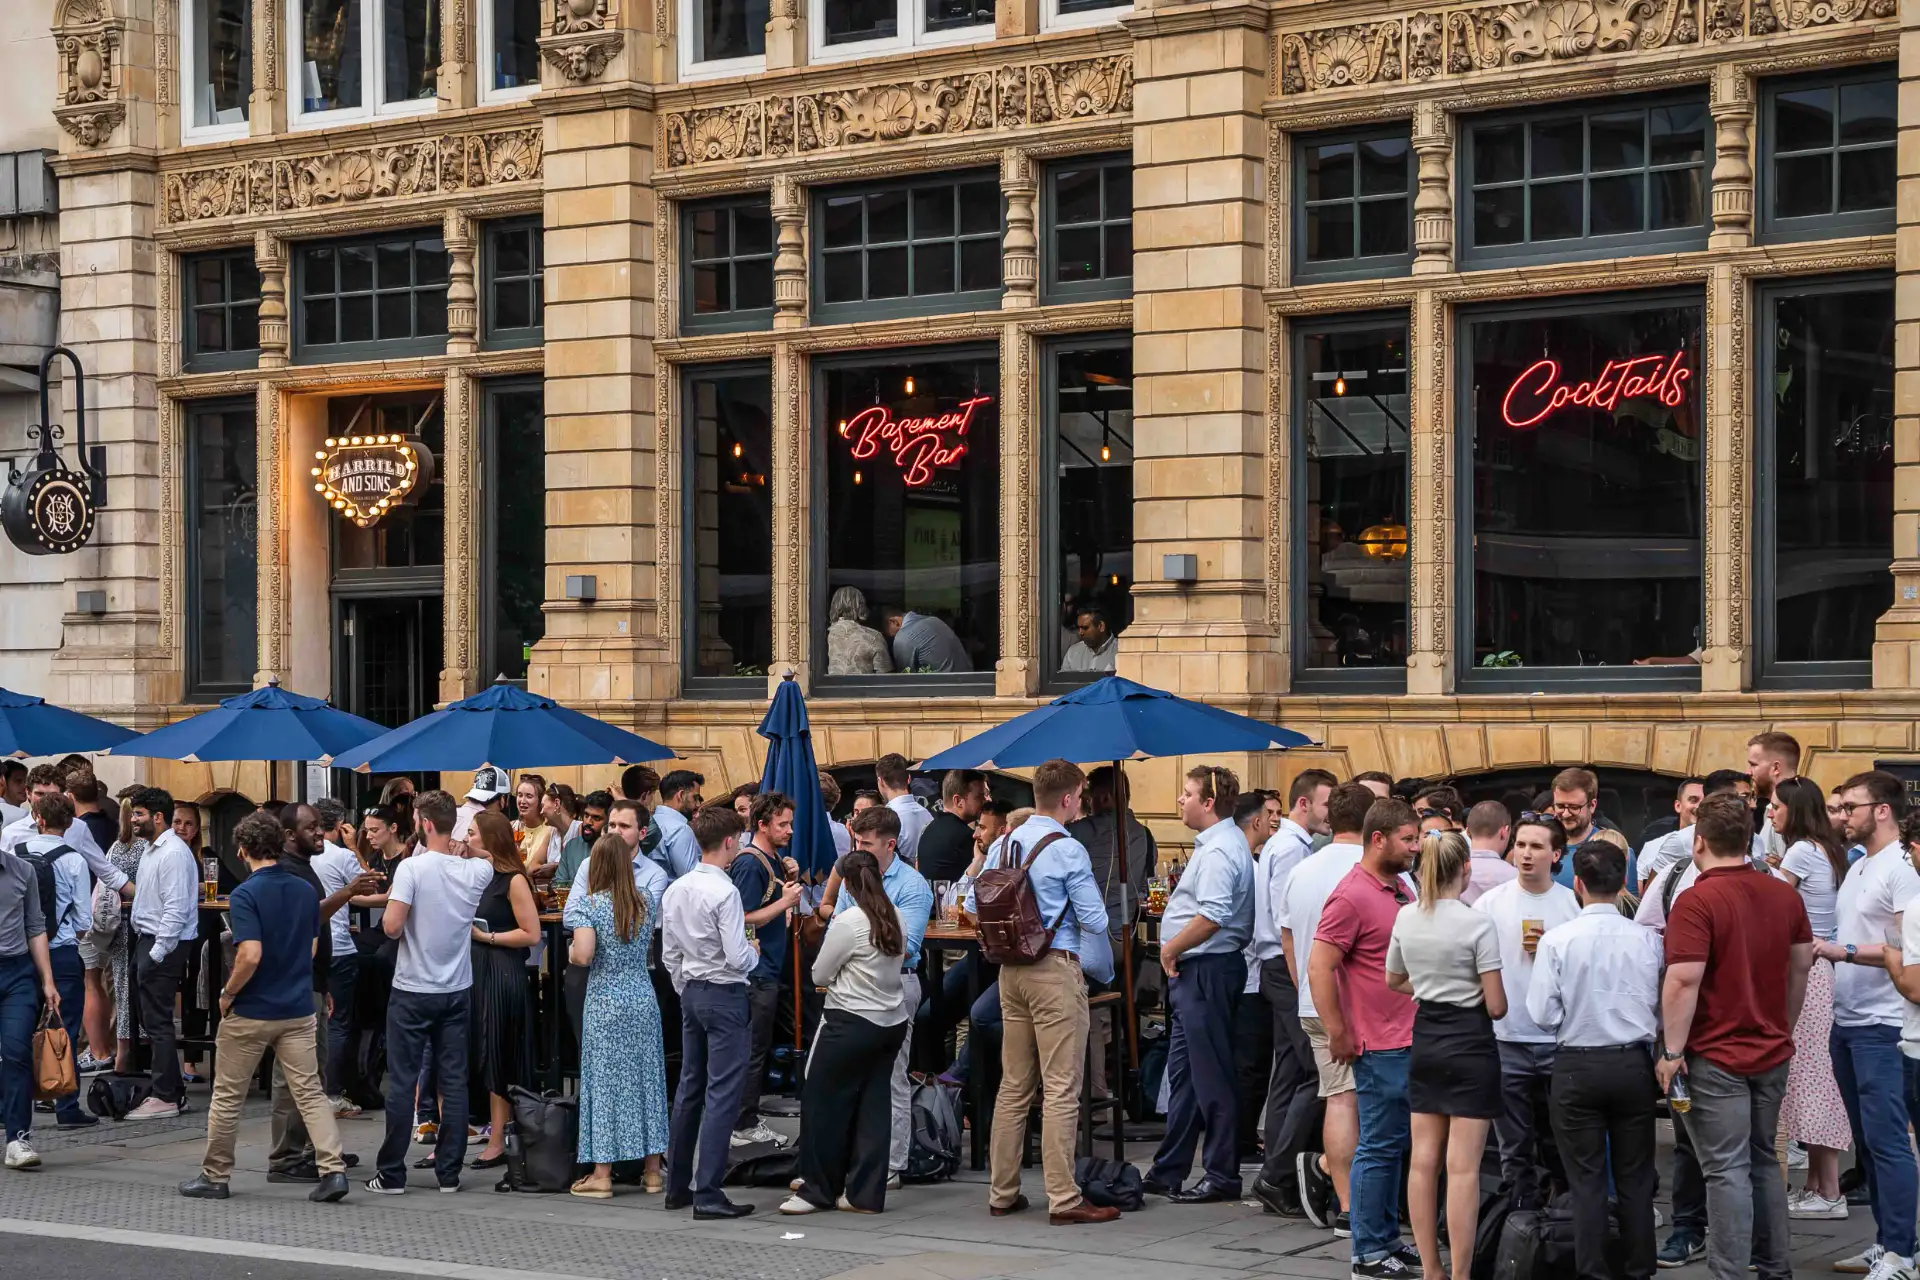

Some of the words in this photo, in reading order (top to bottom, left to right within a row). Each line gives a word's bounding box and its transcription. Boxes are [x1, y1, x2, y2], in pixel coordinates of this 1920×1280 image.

[328, 458, 406, 483] HARRILD
[896, 433, 964, 486] Bar
[341, 475, 362, 495] AND
[364, 475, 391, 492] SONS
